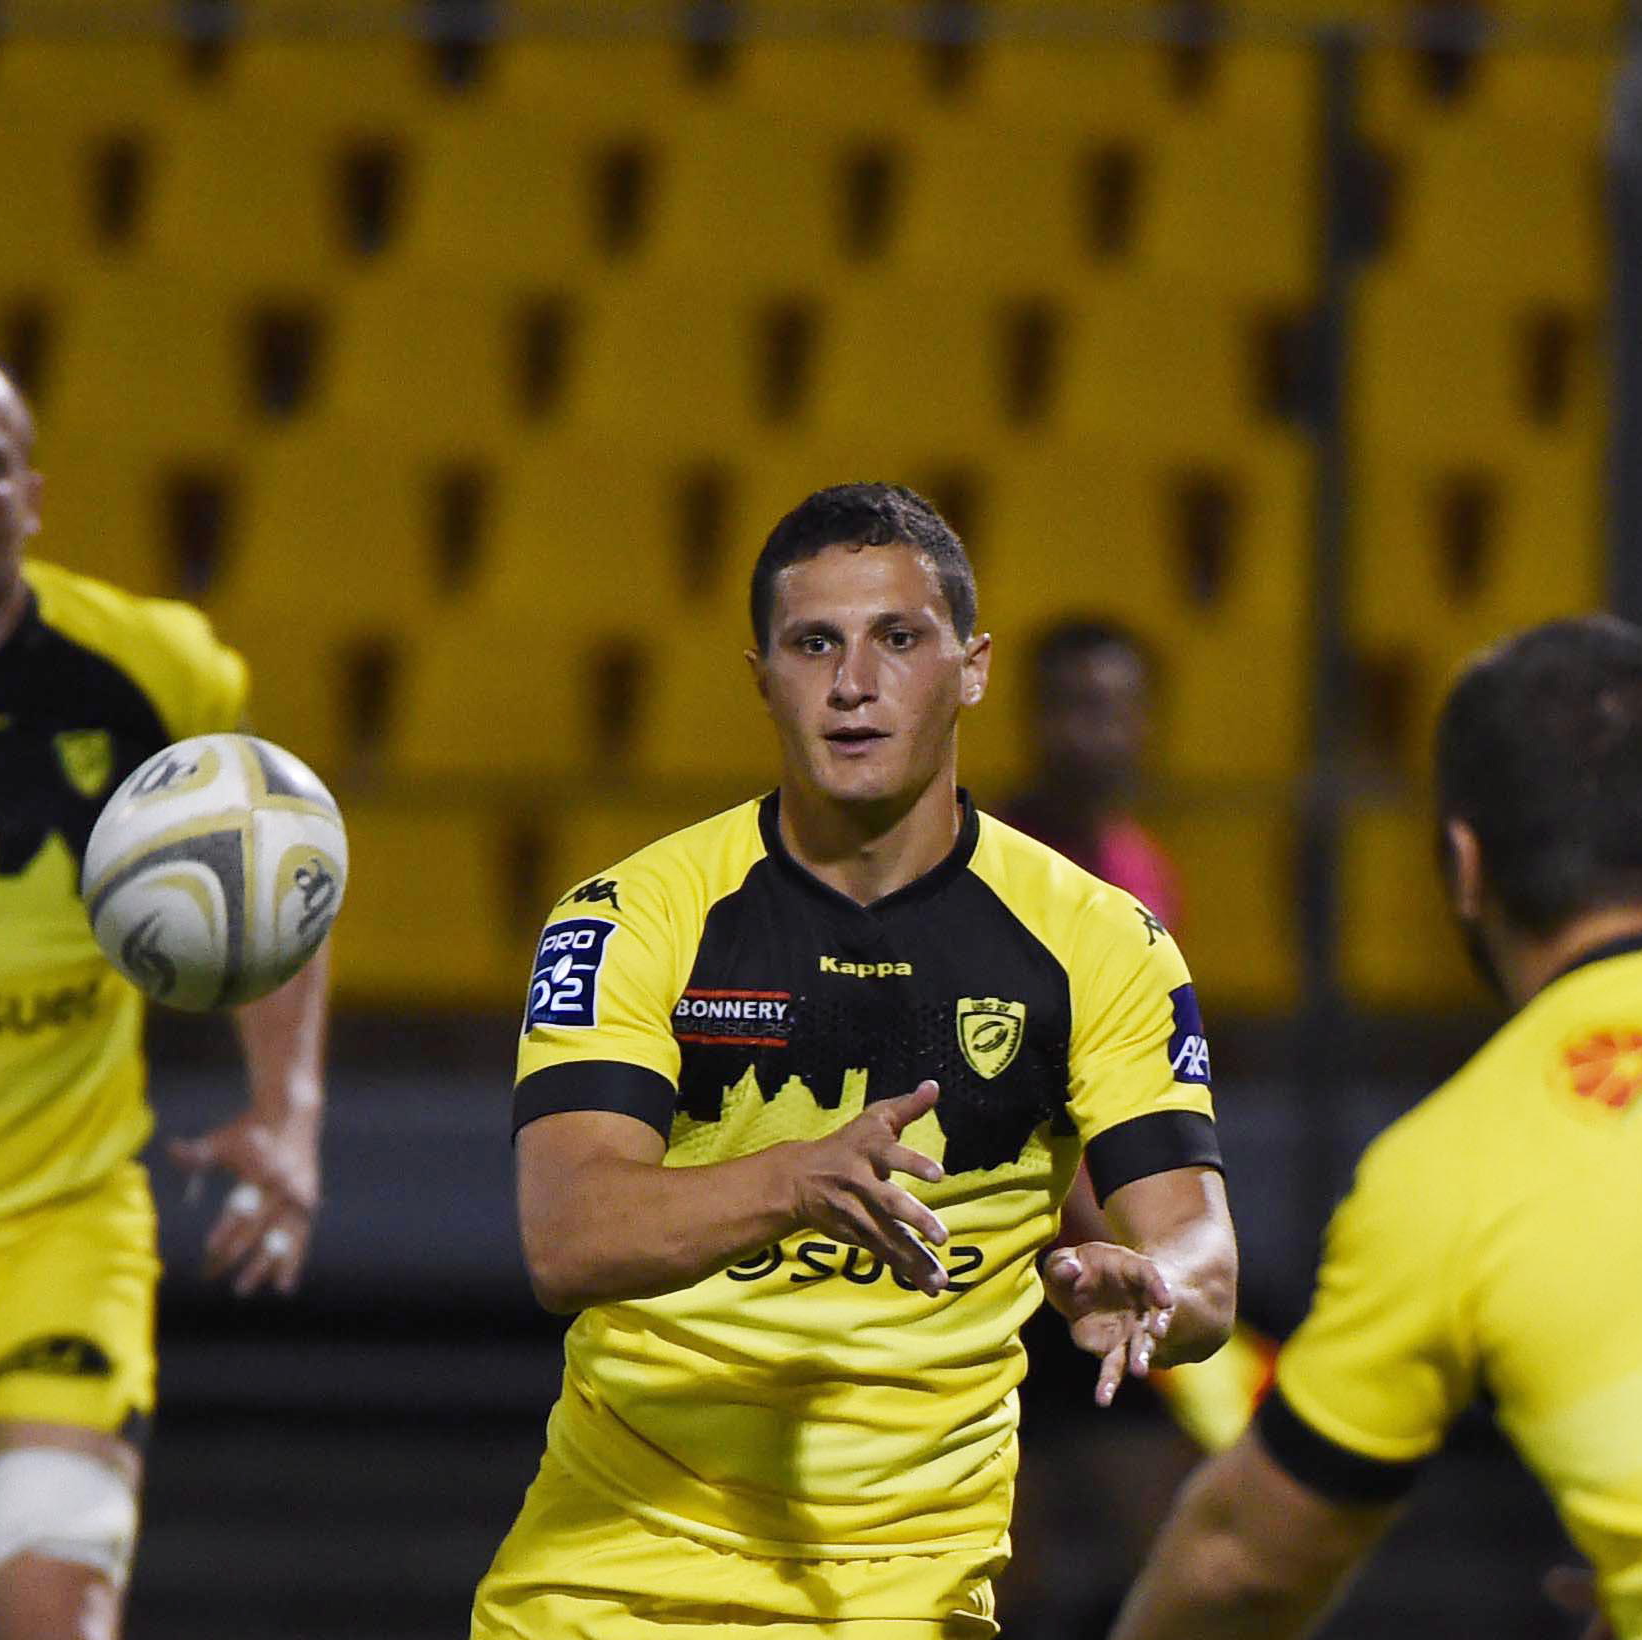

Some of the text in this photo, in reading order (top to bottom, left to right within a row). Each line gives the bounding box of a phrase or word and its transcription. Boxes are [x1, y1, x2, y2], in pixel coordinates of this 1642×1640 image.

[539, 929, 597, 957] PRO
[819, 955, 913, 978] Kappa
[675, 999, 789, 1020] BONNERY
[1172, 1035, 1212, 1081] AXA
